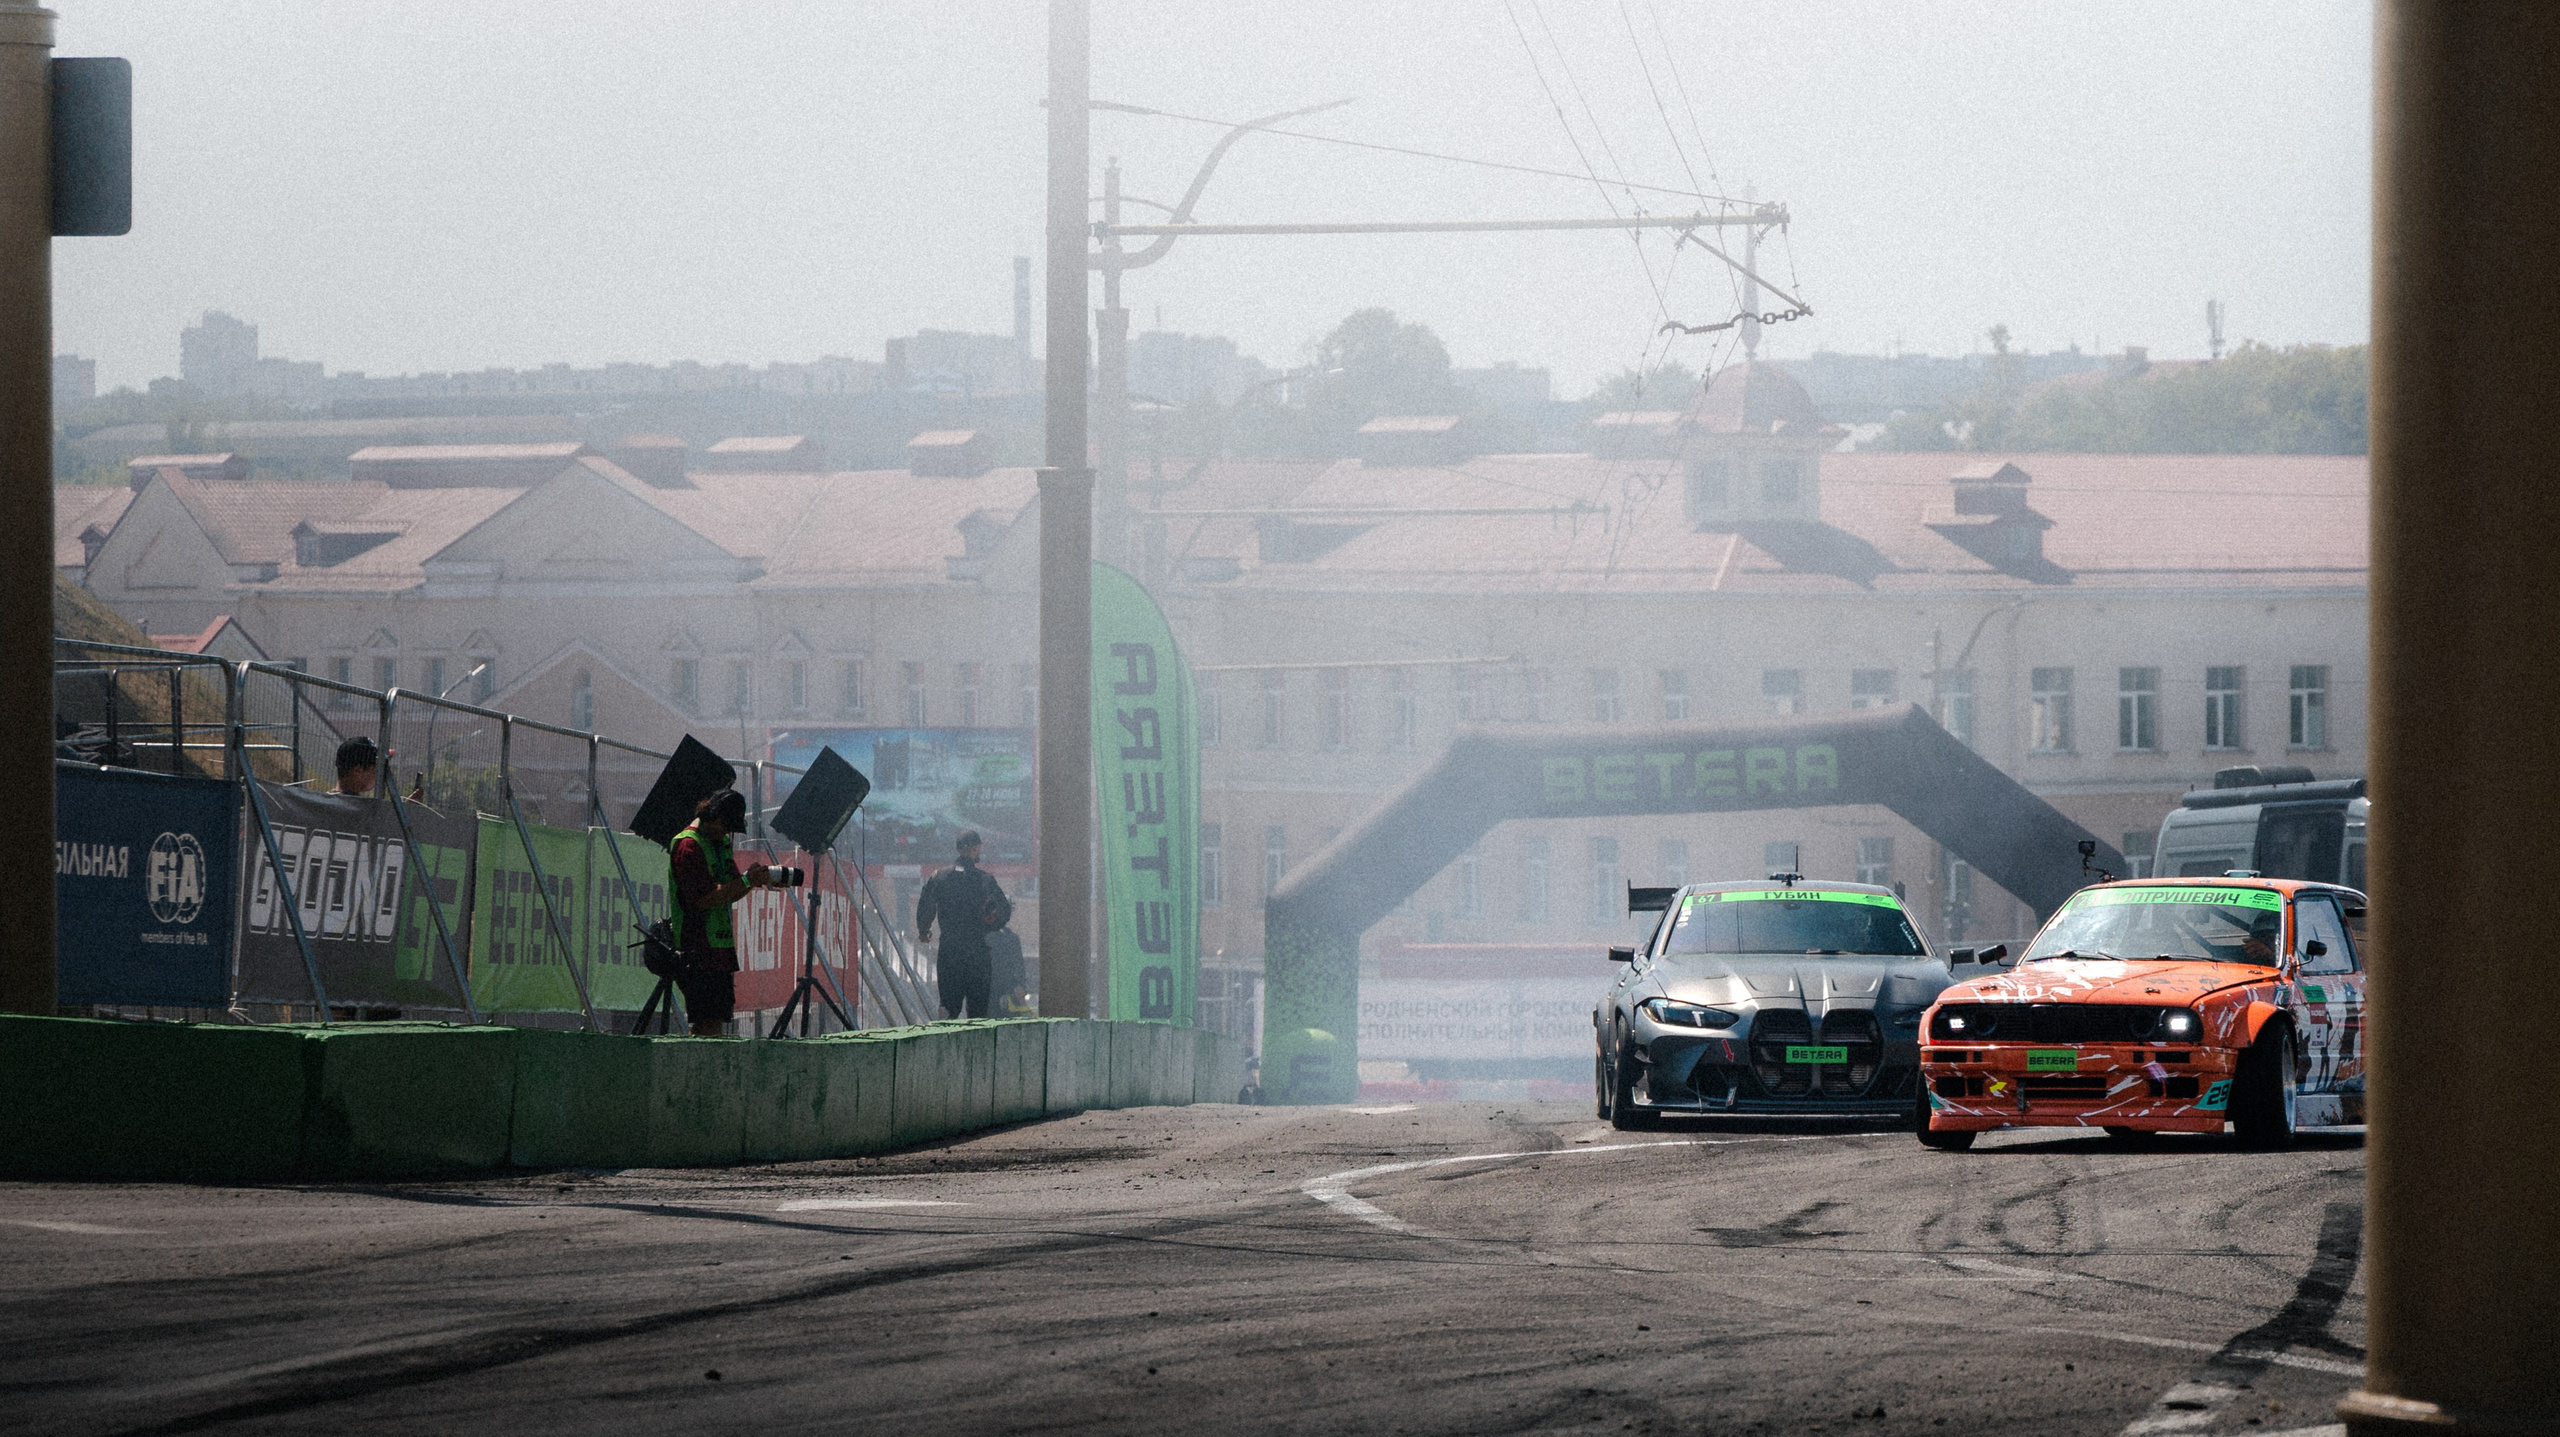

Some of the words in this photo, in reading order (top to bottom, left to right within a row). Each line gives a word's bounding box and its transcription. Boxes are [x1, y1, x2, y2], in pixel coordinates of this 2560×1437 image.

[1698, 894, 1716, 904] 67
[1764, 891, 1821, 900] ГУБИН
[2111, 890, 2241, 904] ОПТРУШЕВИЧ
[1791, 1050, 1843, 1060] BETERA
[2029, 1056, 2076, 1066] BETERA
[2207, 1082, 2230, 1106] 29
